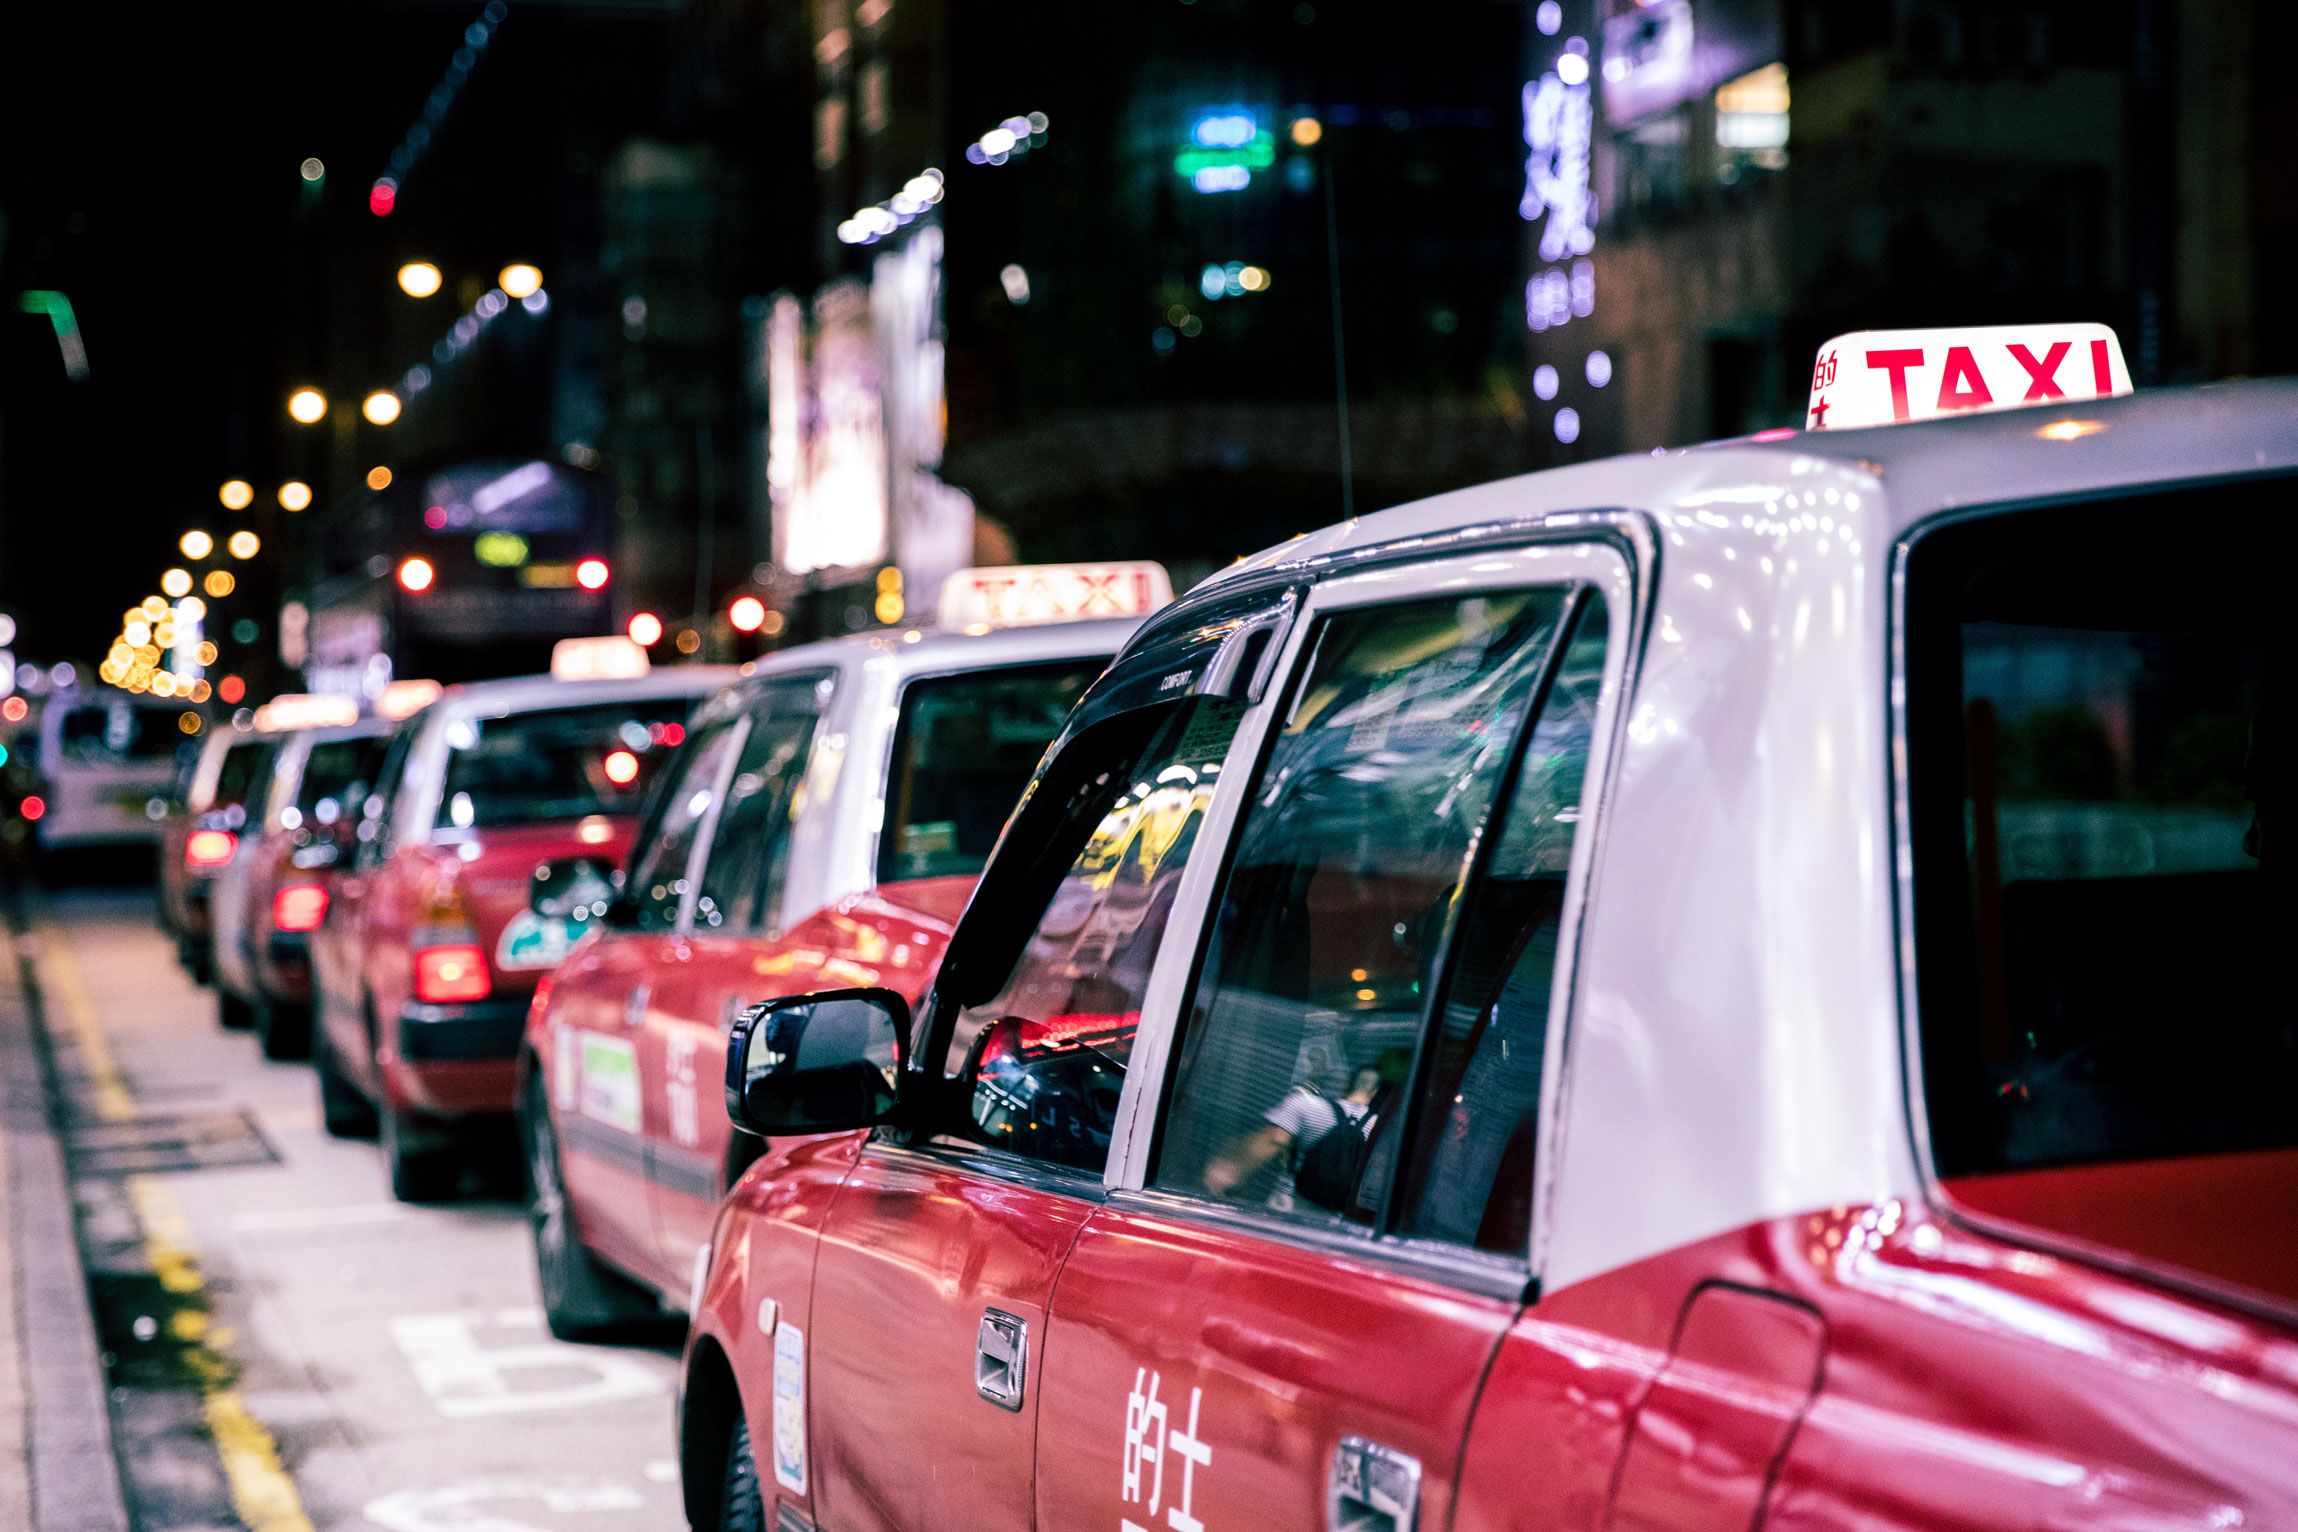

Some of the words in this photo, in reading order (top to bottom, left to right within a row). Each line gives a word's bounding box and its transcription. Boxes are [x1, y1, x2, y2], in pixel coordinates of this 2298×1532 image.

[1810, 349, 1838, 431] 的士
[1865, 339, 2113, 423] TAXI
[972, 572, 1151, 619] TAXI
[1121, 1366, 1213, 1532] 的士
